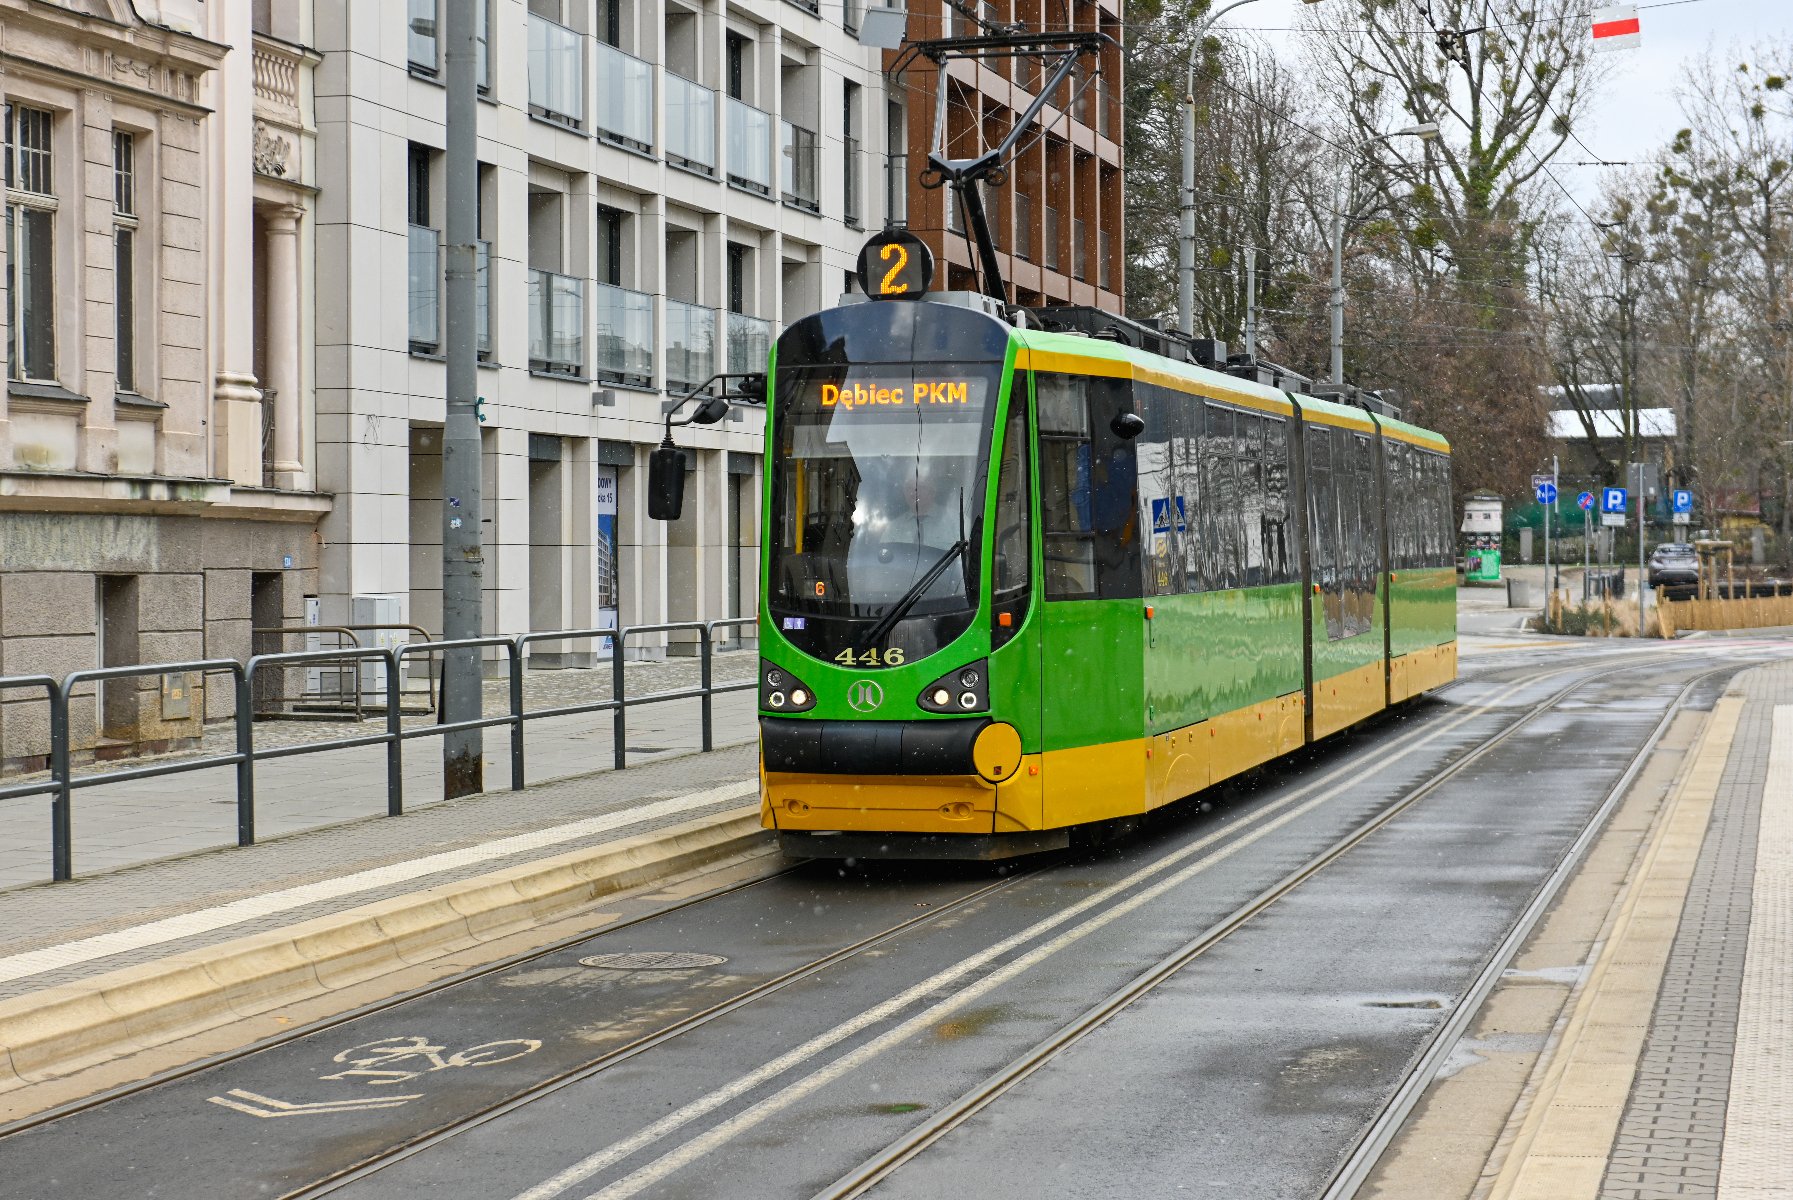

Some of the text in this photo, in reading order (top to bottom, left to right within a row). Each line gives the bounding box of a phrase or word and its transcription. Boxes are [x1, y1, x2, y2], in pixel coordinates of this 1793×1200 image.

[881, 244, 908, 294] 2
[822, 382, 967, 410] Dębiec PKM
[1607, 490, 1623, 509] P
[1677, 492, 1689, 507] P
[815, 581, 825, 596] 6
[834, 647, 905, 666] 446
